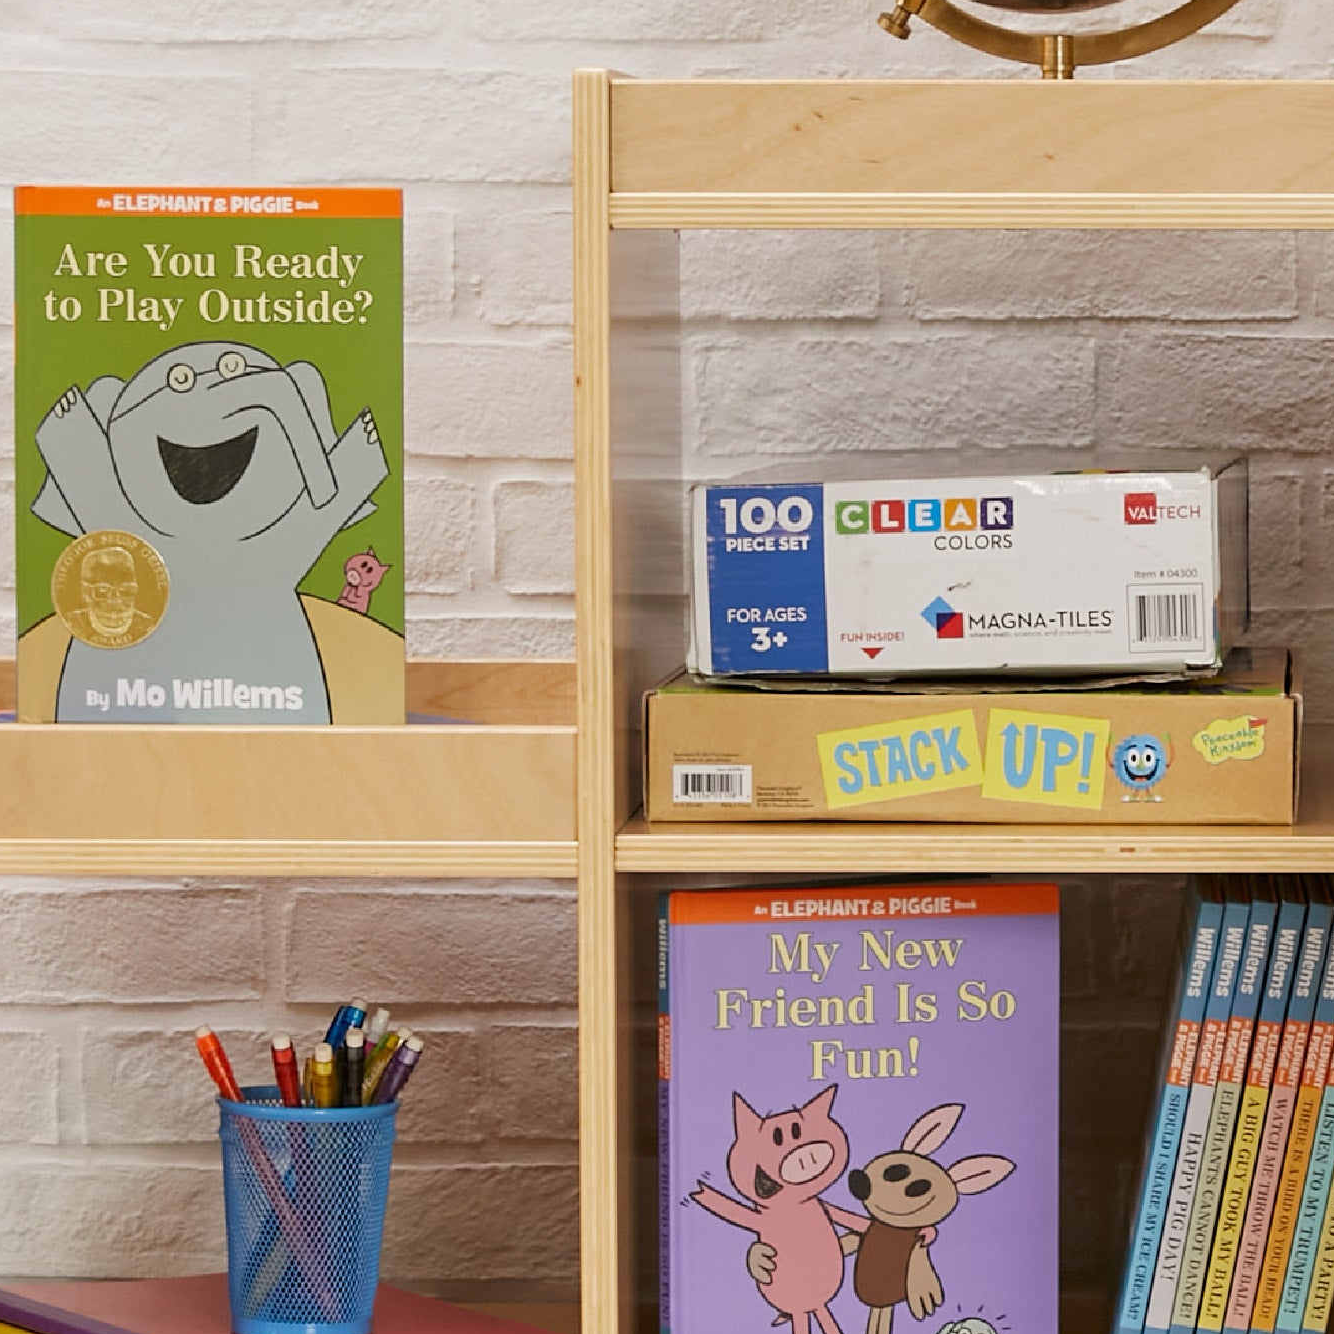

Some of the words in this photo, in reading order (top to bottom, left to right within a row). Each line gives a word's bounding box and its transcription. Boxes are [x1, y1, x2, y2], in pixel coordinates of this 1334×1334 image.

[113, 193, 212, 213] ELEPHANT
[213, 196, 227, 213] &
[230, 195, 294, 214] PIGGIE
[53, 243, 128, 278] Are
[143, 243, 216, 278] You
[234, 245, 363, 287] Ready
[43, 289, 82, 321] to
[97, 290, 184, 331] Play
[199, 288, 374, 324] Outside?
[719, 496, 814, 535] 100
[835, 498, 1014, 535] CLEAR
[1127, 504, 1201, 523] VALTECH
[725, 537, 775, 552] PIECE
[777, 535, 809, 551] SET
[934, 533, 1013, 551] COLORS
[1134, 570, 1156, 578] Item
[1167, 568, 1197, 578] 04300
[726, 608, 757, 623] FOR
[760, 606, 807, 622] AGES
[968, 610, 1112, 629] MAGNA-TILES
[751, 627, 787, 651] 3+
[840, 633, 864, 642] FUN
[865, 632, 905, 642] INSIDE!
[86, 689, 110, 711] By
[116, 679, 165, 709] Mo
[173, 679, 304, 711] Willems
[833, 725, 972, 795] STACK
[1001, 721, 1096, 795] UP!
[770, 898, 870, 917] ELEPHANT
[872, 900, 886, 916] &
[889, 897, 951, 915] PIGGIE
[657, 918, 667, 990] Willems
[768, 933, 840, 982] My
[860, 930, 965, 971] New
[1185, 928, 1216, 997] Willems
[1214, 927, 1244, 997] Willems
[1239, 924, 1269, 994] Willems
[1267, 929, 1298, 998] Willems
[1295, 928, 1325, 997] Willems
[715, 988, 877, 1029] Friend
[896, 983, 939, 1023] Is
[958, 981, 1017, 1020] So
[810, 1037, 922, 1081] Fun!
[1179, 1032, 1199, 1086] ELEPHANT
[1207, 1031, 1226, 1086] ELEPHANT
[1231, 1029, 1251, 1083] ELEPHANT
[1259, 1033, 1280, 1087] ELEPHANT
[1287, 1032, 1307, 1086] ELEPHANT
[1313, 1034, 1333, 1088] ELEPHANT
[1159, 1094, 1182, 1149] SHOULD
[1248, 1098, 1262, 1109] A
[1267, 1098, 1288, 1151] WATCH
[1296, 1099, 1314, 1146] THERE
[1203, 1090, 1235, 1185] ELEPHANTS
[1241, 1114, 1258, 1143] BIG
[1177, 1133, 1203, 1193] HAPPY
[1233, 1149, 1252, 1181] GUY
[1261, 1156, 1276, 1177] ME
[1289, 1167, 1300, 1175] A
[1292, 1149, 1304, 1162] IS
[1147, 1162, 1169, 1210] SHARE
[1281, 1179, 1298, 1212] BIRD
[1309, 1169, 1326, 1191] TO
[1142, 1213, 1158, 1234] MY
[1170, 1201, 1188, 1231] PIG
[1190, 1190, 1216, 1254] CANNOT
[1223, 1187, 1244, 1232] TOOK
[1249, 1181, 1271, 1236] THROW
[1277, 1215, 1290, 1233] ON
[1303, 1197, 1320, 1221] MY
[1138, 1238, 1154, 1261] ICE
[1160, 1238, 1182, 1280] DAY!
[1217, 1239, 1233, 1262] MY
[1242, 1240, 1259, 1269] THE
[1268, 1238, 1285, 1273] YOUR
[1283, 1227, 1314, 1313] TRUMPET!
[1126, 1265, 1149, 1320] CREAM?
[1179, 1260, 1202, 1318] DANCE!
[1205, 1269, 1228, 1318] BALL!
[1232, 1274, 1252, 1316] BALL!
[1259, 1277, 1277, 1318] HEAD!
[1310, 1258, 1334, 1319] PARTY!
